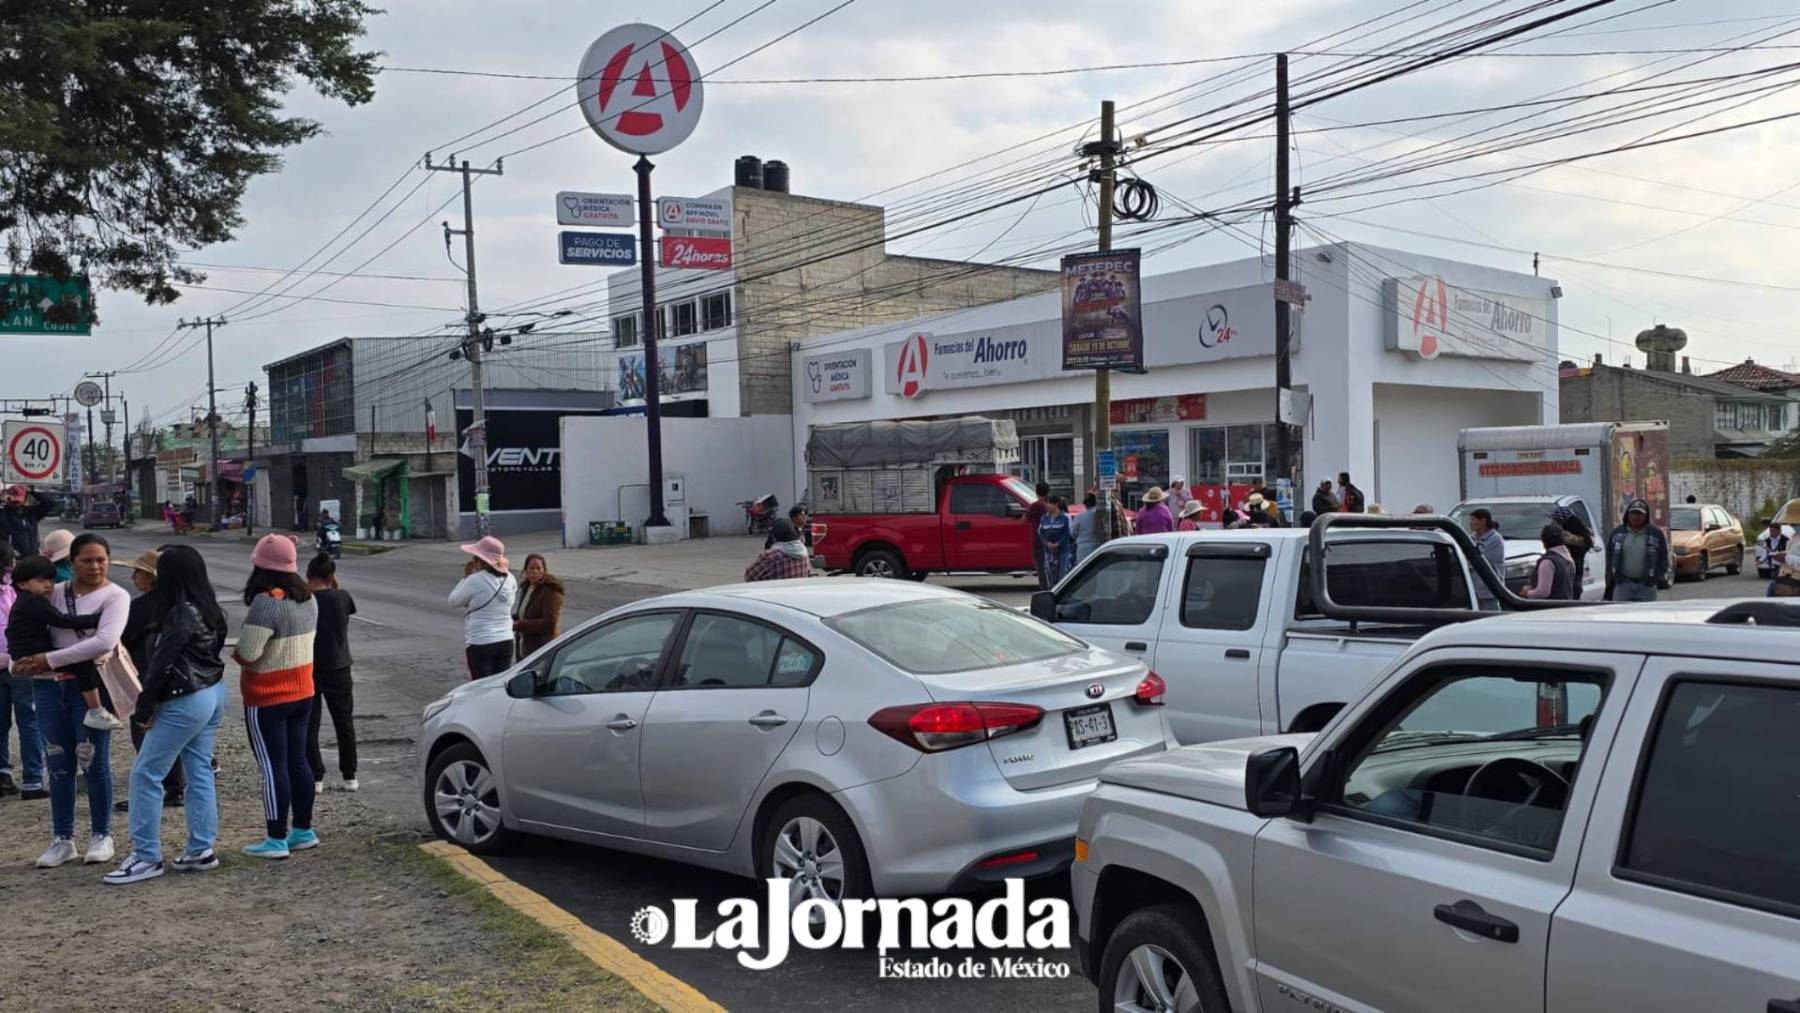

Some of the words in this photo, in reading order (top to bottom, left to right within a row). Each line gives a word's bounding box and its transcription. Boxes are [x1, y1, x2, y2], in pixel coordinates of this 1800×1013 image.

[583, 212, 619, 220] GRATUITA
[574, 237, 604, 248] PAGO
[607, 238, 621, 248] DE
[566, 247, 632, 260] SERVICIOS
[1065, 261, 1133, 276] METEPEC
[1491, 301, 1532, 334] Ahorro
[934, 342, 964, 355] Farmacias
[973, 336, 1027, 363] Ahorro
[23, 438, 49, 461] 40
